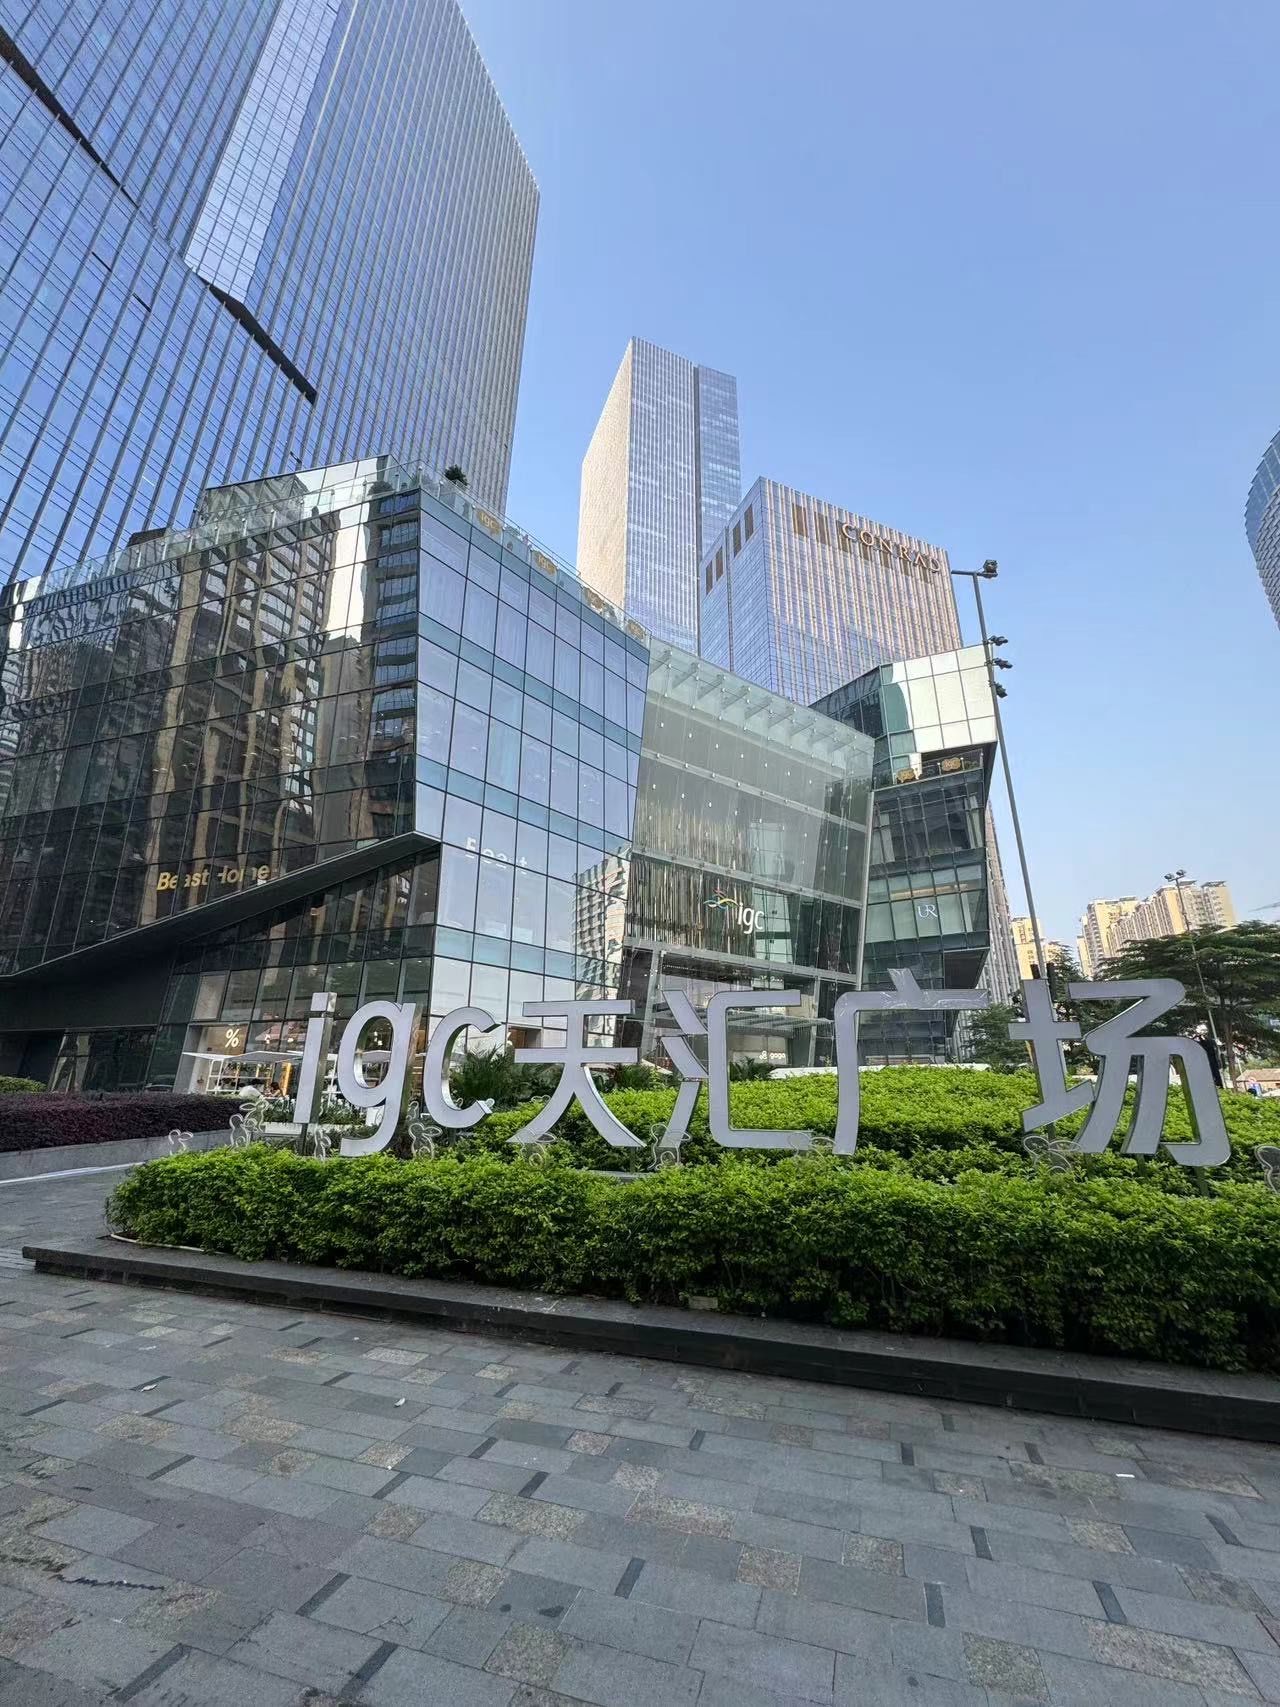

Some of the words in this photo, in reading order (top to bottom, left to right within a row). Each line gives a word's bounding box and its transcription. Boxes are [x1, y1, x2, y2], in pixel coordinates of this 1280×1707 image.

[842, 523, 941, 574] CONRAD
[464, 836, 528, 875] Beat
[156, 868, 210, 891] Beast
[737, 901, 765, 935] igc
[917, 904, 939, 918] UR
